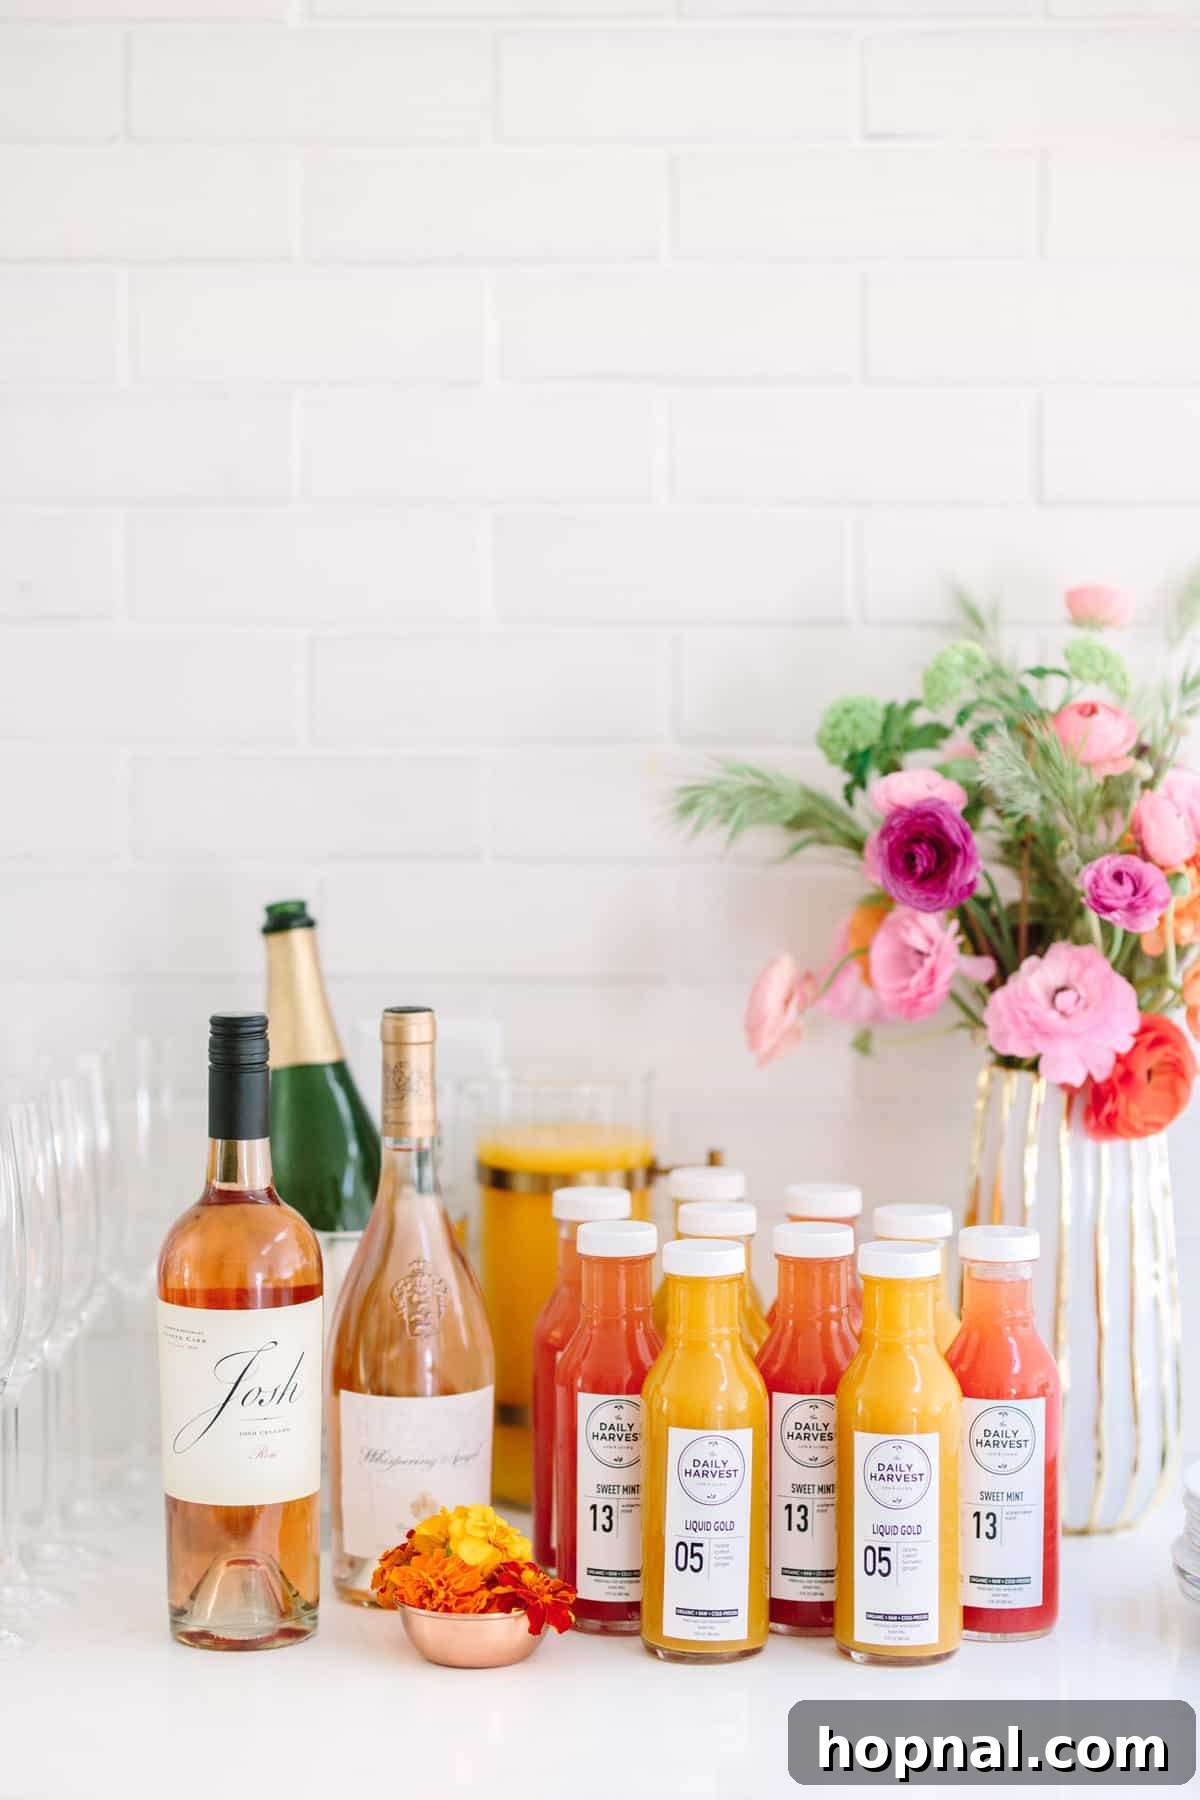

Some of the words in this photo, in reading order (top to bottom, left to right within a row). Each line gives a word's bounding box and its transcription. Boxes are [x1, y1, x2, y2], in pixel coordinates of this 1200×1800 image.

[173, 1341, 305, 1454] Josh
[599, 1422, 634, 1432] DAILY
[794, 1422, 830, 1431] DAILY
[592, 1431, 641, 1442] HARVES
[786, 1431, 834, 1441] HARVES
[983, 1429, 1019, 1438] DAILY
[975, 1438, 1030, 1449] HARVEST
[692, 1458, 728, 1468] DAILY
[877, 1463, 913, 1472] DAILY
[684, 1469, 739, 1479] HARVEST
[870, 1472, 925, 1483] HARVEST
[596, 1483, 620, 1495] SWEET
[791, 1483, 815, 1495] SWEET
[979, 1491, 1005, 1502] SWEET
[1006, 1491, 1024, 1502] MINT
[589, 1503, 613, 1533] 13
[784, 1503, 808, 1532] 13
[684, 1520, 712, 1533] LIQUID
[713, 1521, 735, 1532] GOLD
[872, 1523, 899, 1537] LIQUID
[900, 1524, 922, 1536] GOLD
[972, 1511, 997, 1540] 13
[675, 1541, 704, 1573] 05
[864, 1545, 892, 1577] 05
